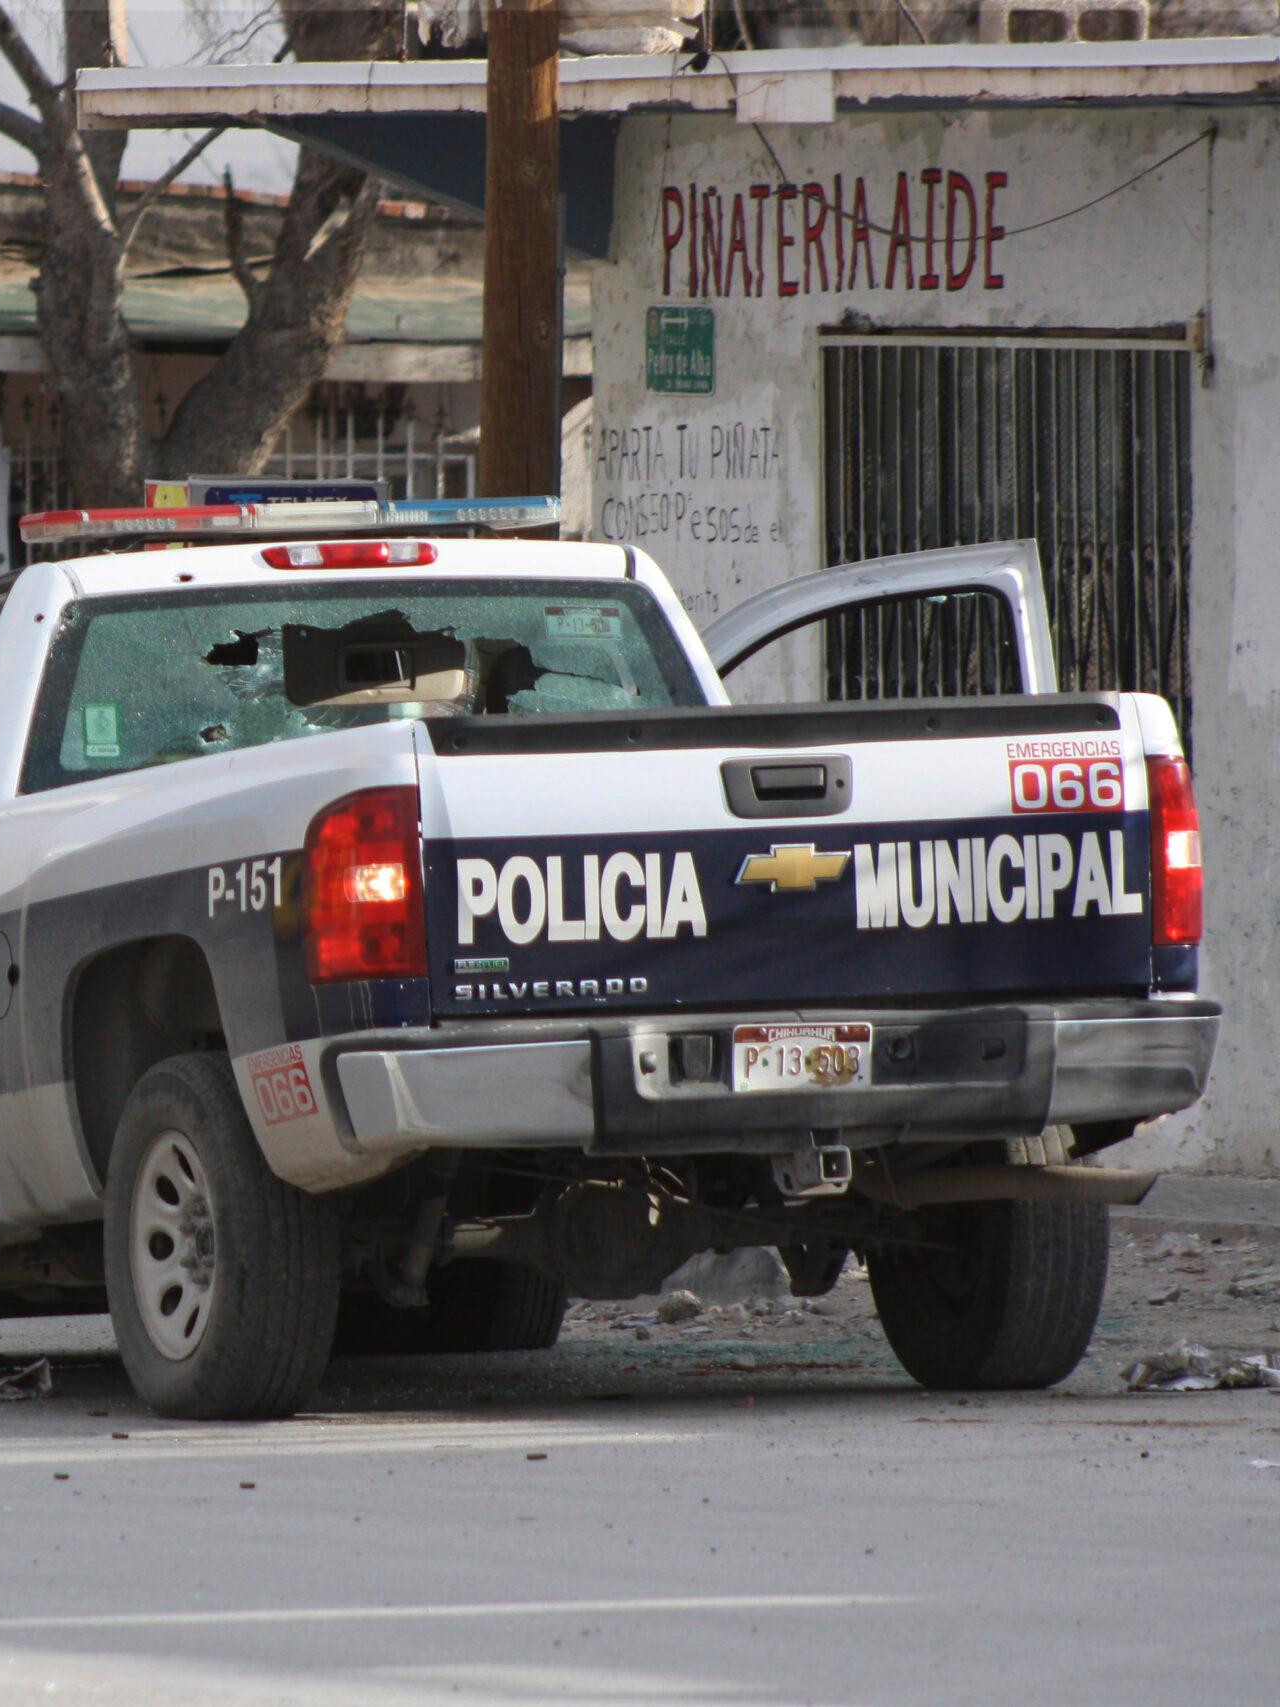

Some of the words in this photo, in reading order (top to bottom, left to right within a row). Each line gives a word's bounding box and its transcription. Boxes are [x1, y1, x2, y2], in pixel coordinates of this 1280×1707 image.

[885, 167, 1008, 292] AIDE
[647, 347, 674, 375] Pedro
[676, 352, 689, 375] de
[690, 348, 711, 376] Alba
[595, 425, 666, 481] APARTA
[1007, 740, 1121, 759] EMERGENCIAS
[1014, 762, 1122, 809] 066
[208, 856, 282, 918] P-151
[456, 852, 708, 945] POLICIA
[853, 830, 1143, 930] MUNICIPAL
[455, 977, 648, 1001] SILVERADO
[246, 1044, 303, 1073] EMERGENCIAS
[768, 1027, 836, 1041] CHIHUAHUA
[254, 1067, 314, 1121] 066
